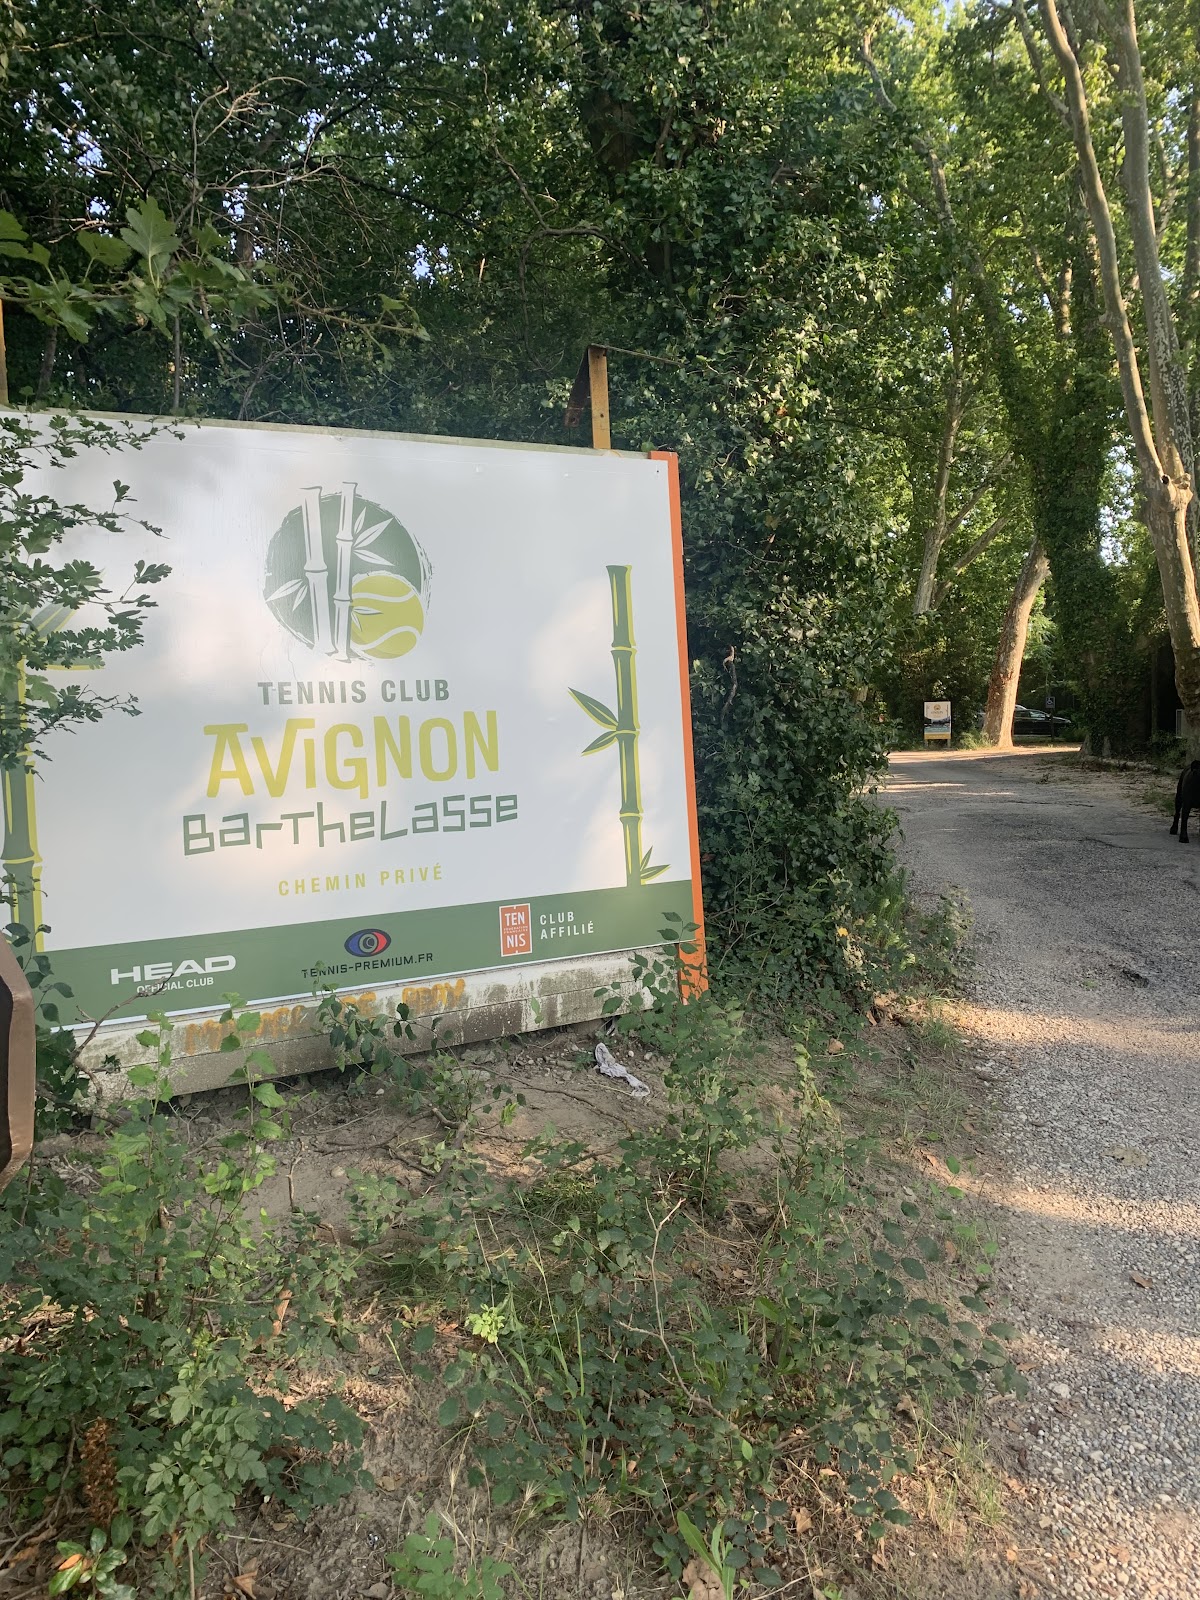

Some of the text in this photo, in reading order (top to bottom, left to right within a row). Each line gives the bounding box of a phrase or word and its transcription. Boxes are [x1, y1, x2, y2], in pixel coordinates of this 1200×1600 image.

[257, 679, 450, 705] TENNIS CLUB
[278, 863, 443, 896] CHEMIN PRIVÉ
[504, 911, 525, 927] TEN
[540, 911, 575, 926] CLUB
[540, 920, 594, 939] AFFILIÉ
[506, 933, 526, 949] NIS
[110, 954, 237, 985] HEAD
[186, 977, 214, 988] CLUB
